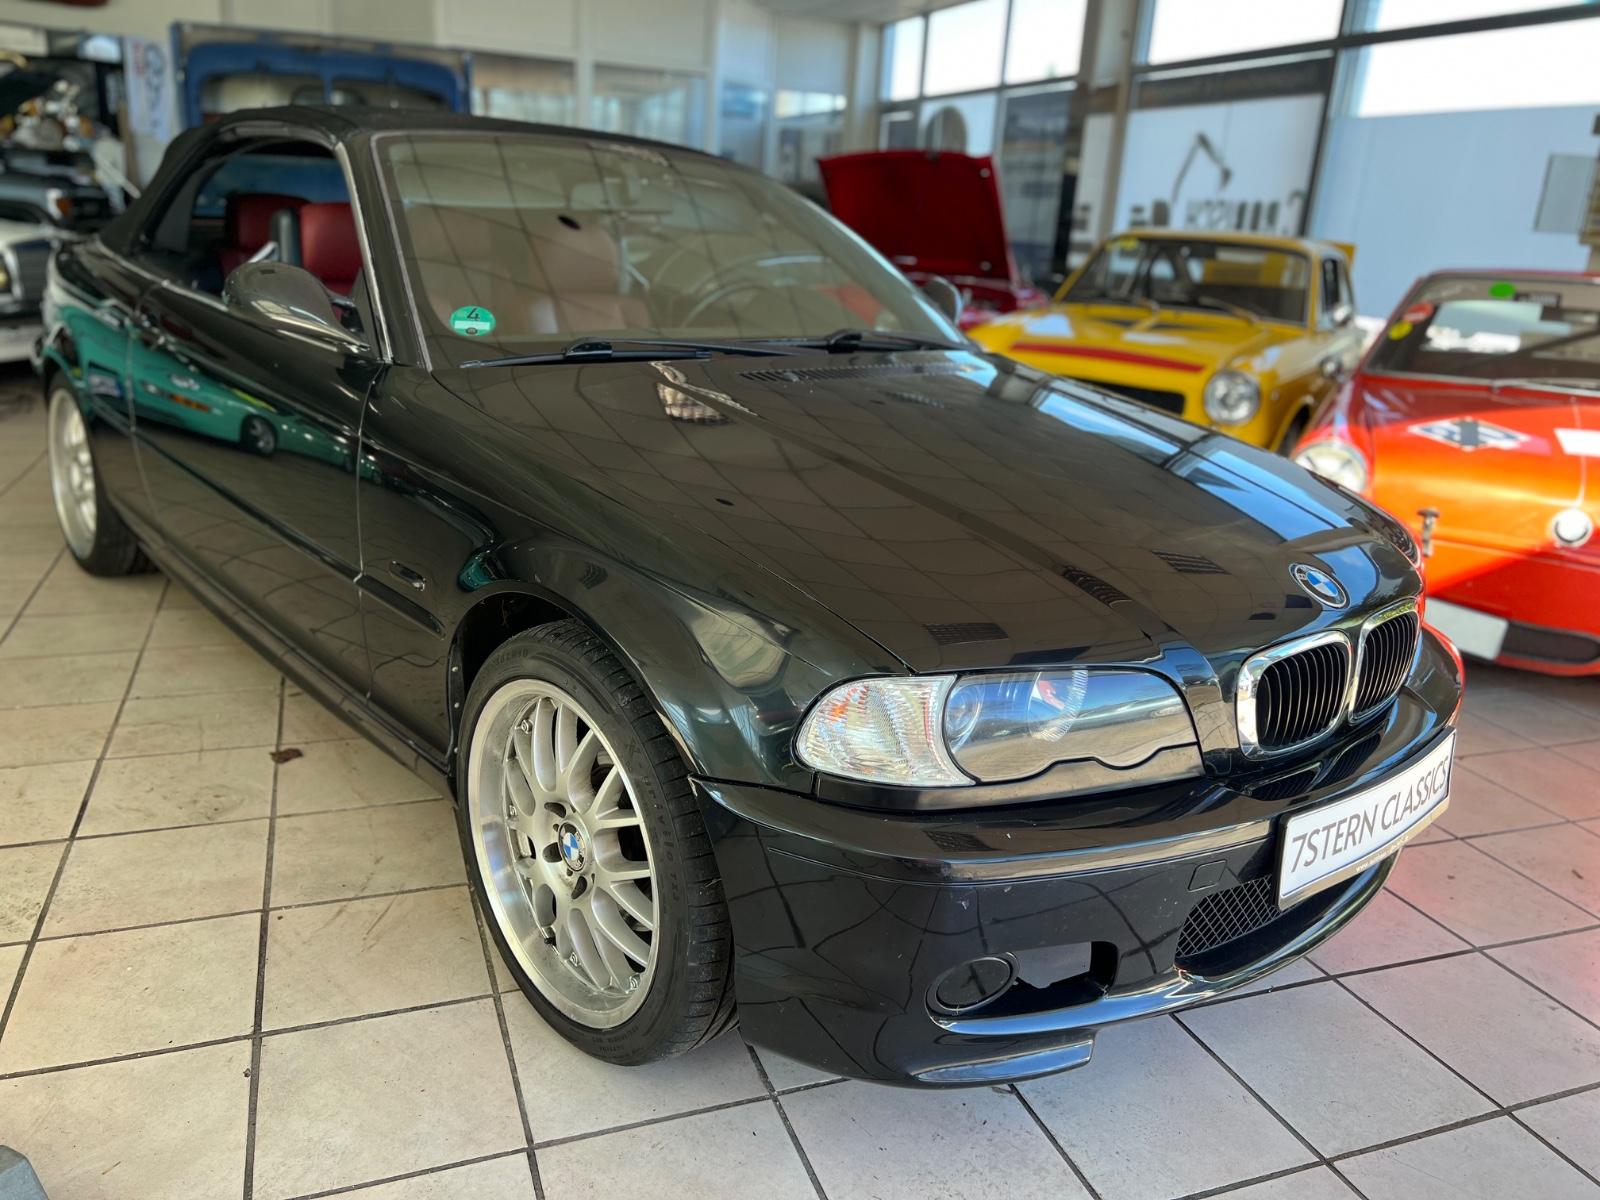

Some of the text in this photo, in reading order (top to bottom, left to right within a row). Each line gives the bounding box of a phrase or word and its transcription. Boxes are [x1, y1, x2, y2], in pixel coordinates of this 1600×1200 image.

[466, 307, 480, 321] 4
[1291, 804, 1378, 873] 7STERN
[1381, 756, 1448, 830] CLASSICS
